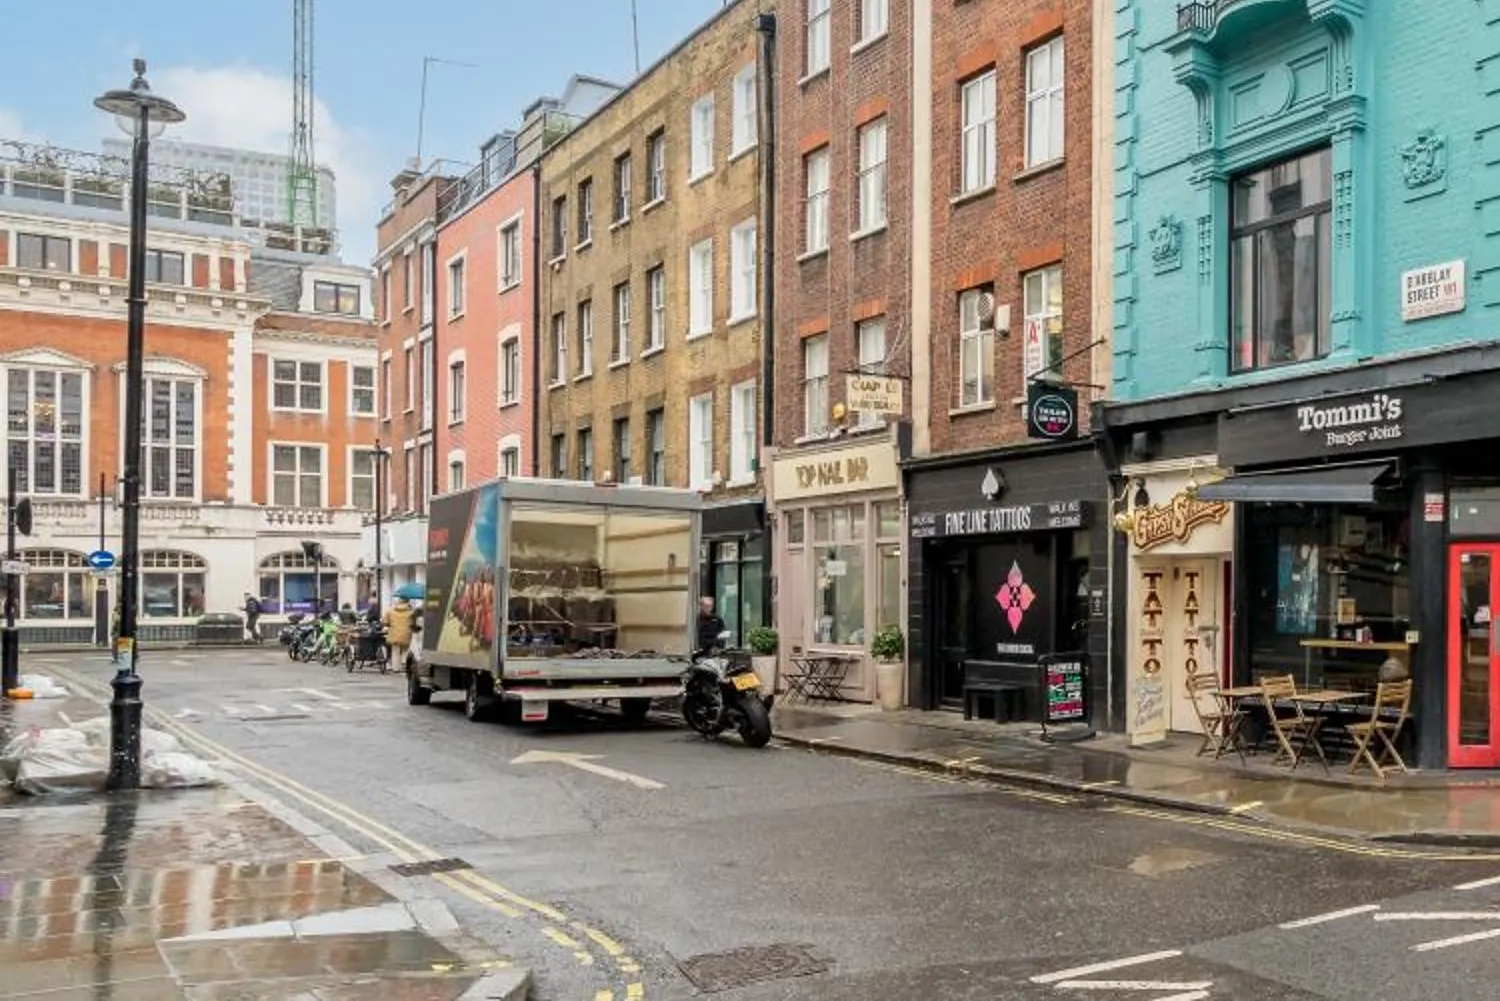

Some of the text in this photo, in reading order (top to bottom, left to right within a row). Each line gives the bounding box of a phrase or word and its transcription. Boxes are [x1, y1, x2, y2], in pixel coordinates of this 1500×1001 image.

[1407, 285, 1440, 304] STREET
[1297, 394, 1403, 431] Tommi's
[1326, 424, 1402, 446] Burger Joint
[796, 456, 868, 488] TOP NAIL BAR
[945, 511, 966, 536] FINE
[967, 509, 987, 534] LINE
[990, 506, 1031, 531] TATTOOS
